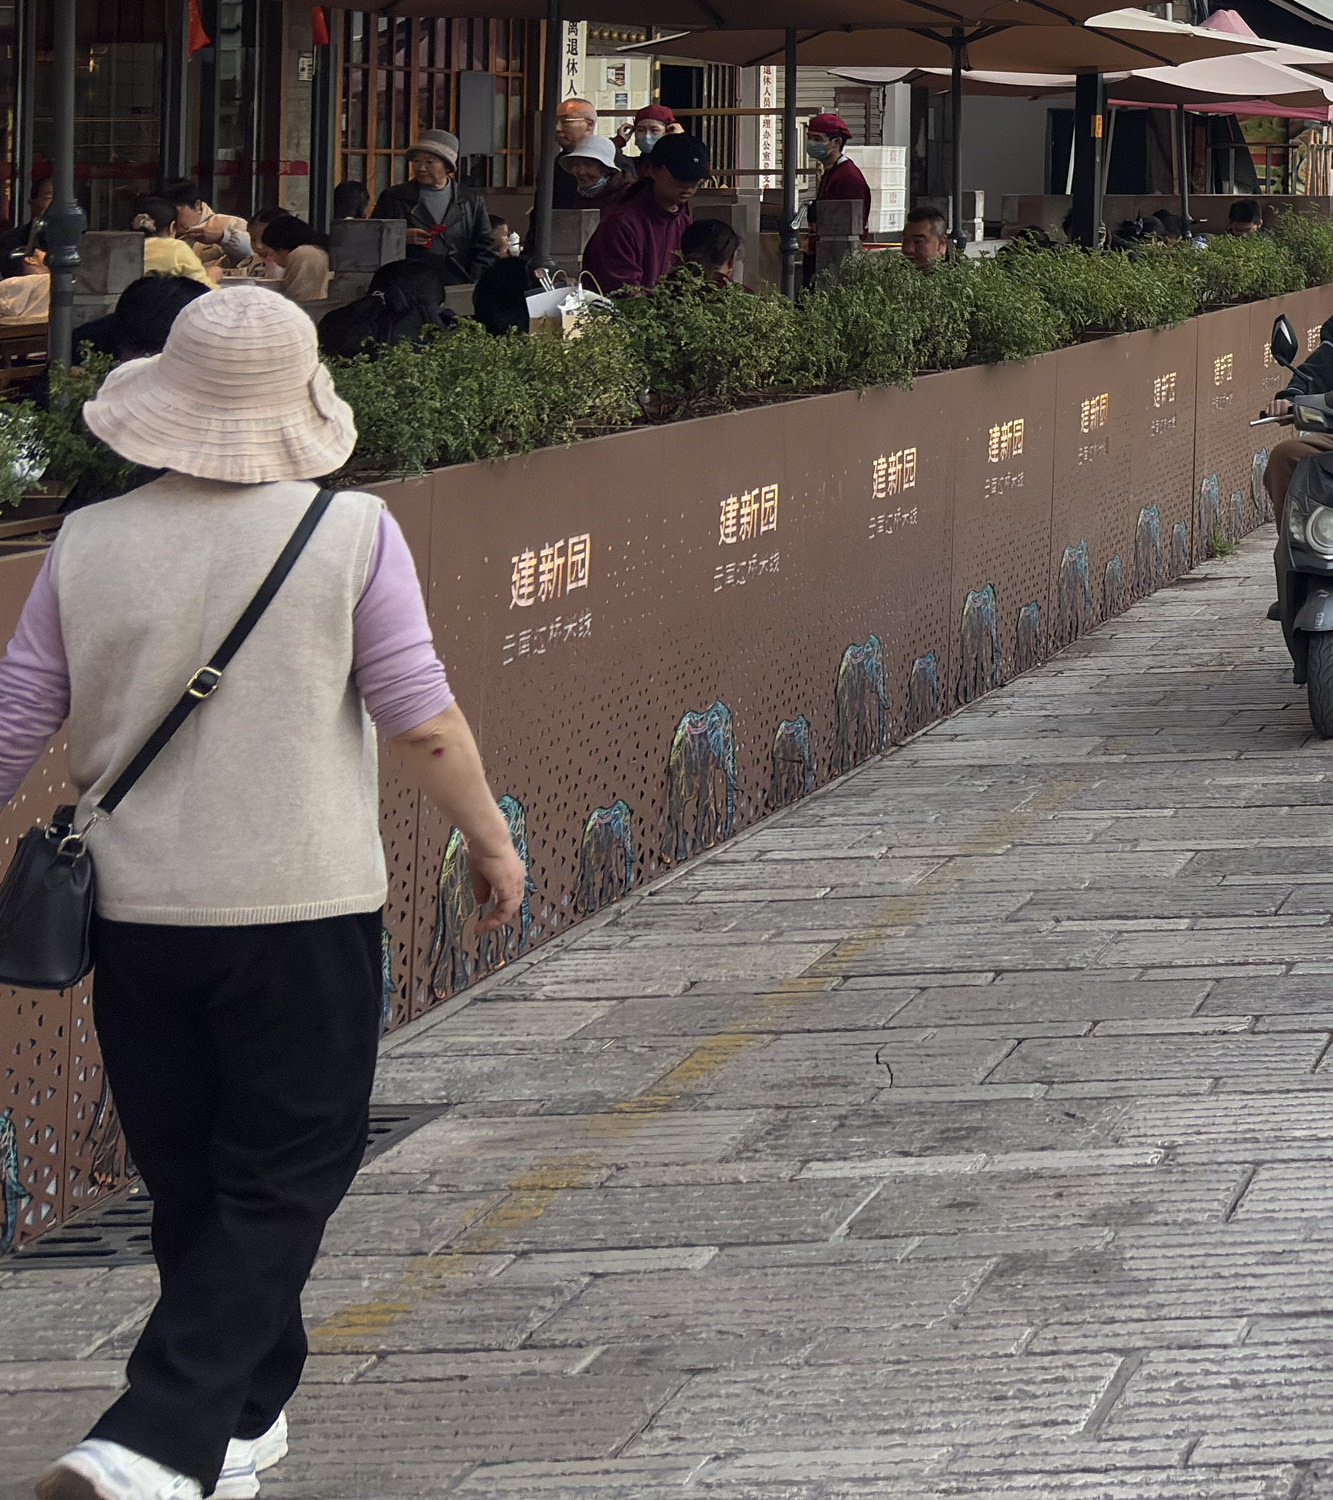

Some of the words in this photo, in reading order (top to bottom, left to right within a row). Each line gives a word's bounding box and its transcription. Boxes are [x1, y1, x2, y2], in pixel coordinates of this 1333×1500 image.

[988, 418, 1025, 463] 建新园
[872, 447, 917, 500] 建新园
[718, 483, 779, 546] 建新园
[509, 532, 591, 610] 建新园
